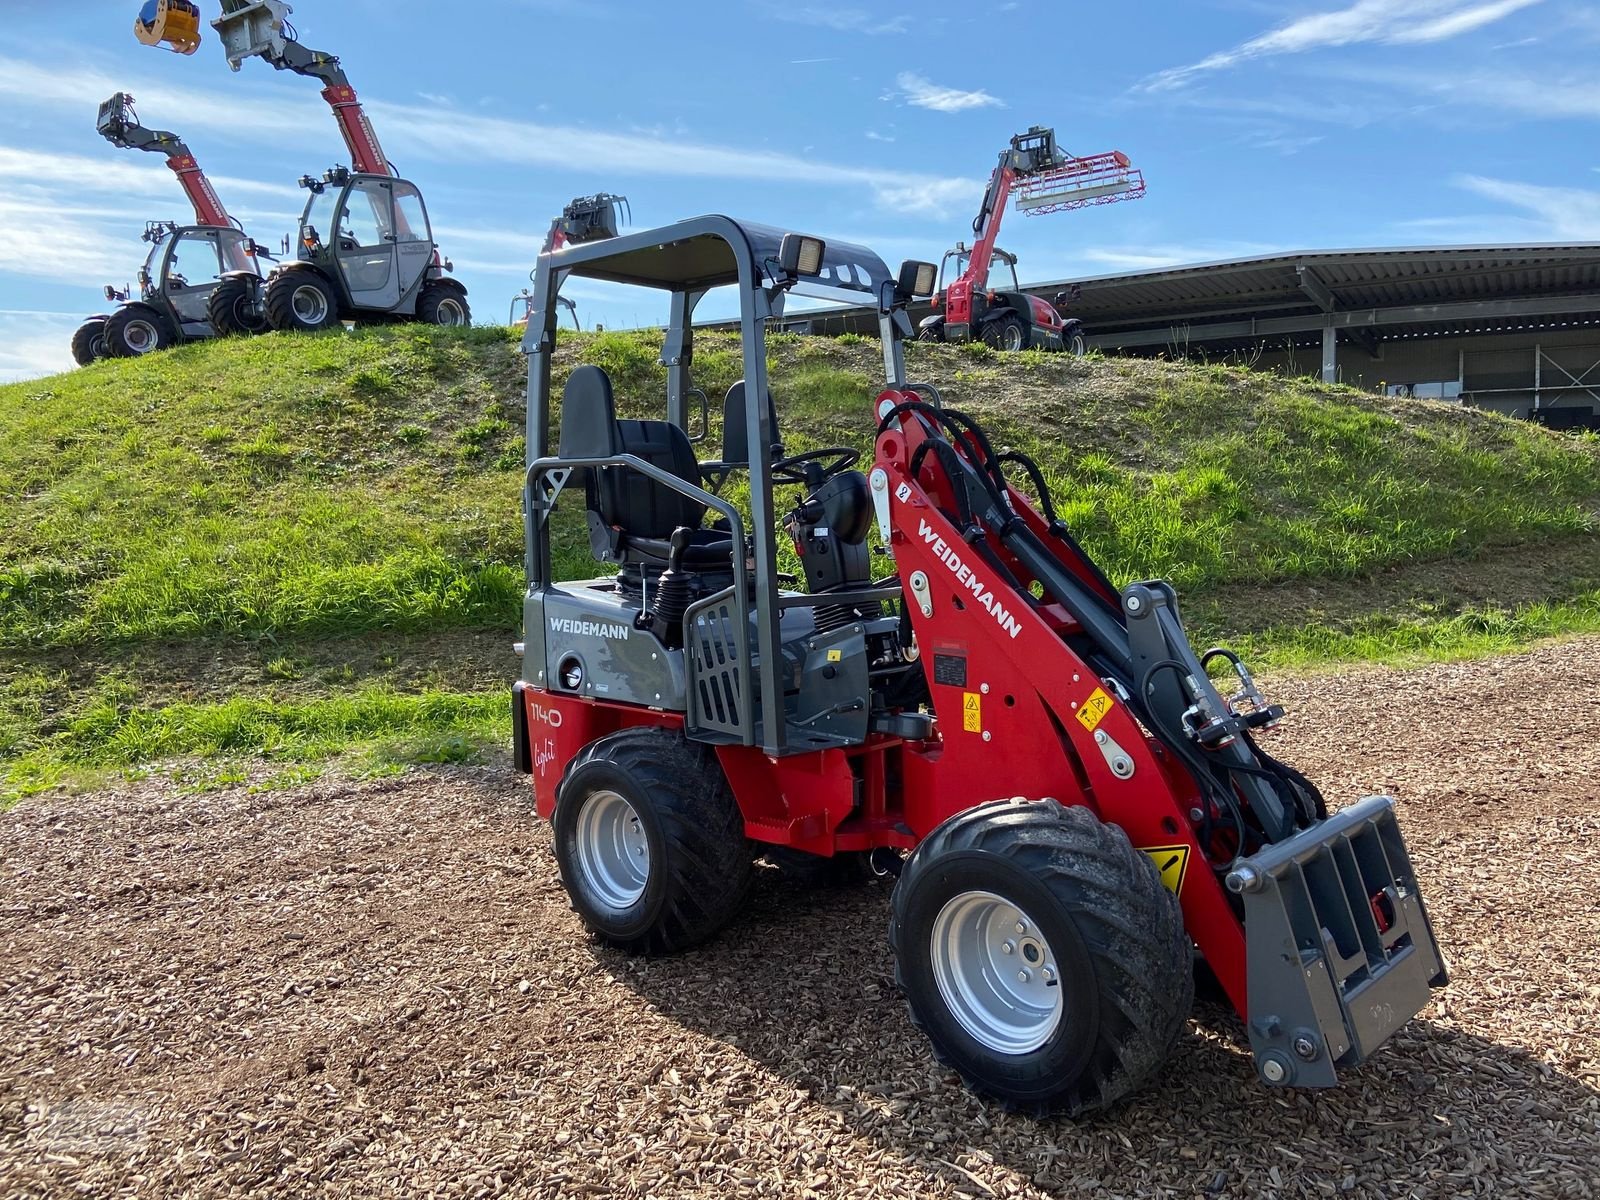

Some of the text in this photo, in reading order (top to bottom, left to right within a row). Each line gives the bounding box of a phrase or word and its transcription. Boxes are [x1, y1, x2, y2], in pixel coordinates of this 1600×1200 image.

[357, 113, 382, 166] WEIDEMANN
[918, 517, 1023, 639] WEIDEMANN
[550, 617, 629, 640] WEIDEMANN
[531, 702, 563, 728] 1140
[534, 737, 556, 777] light
